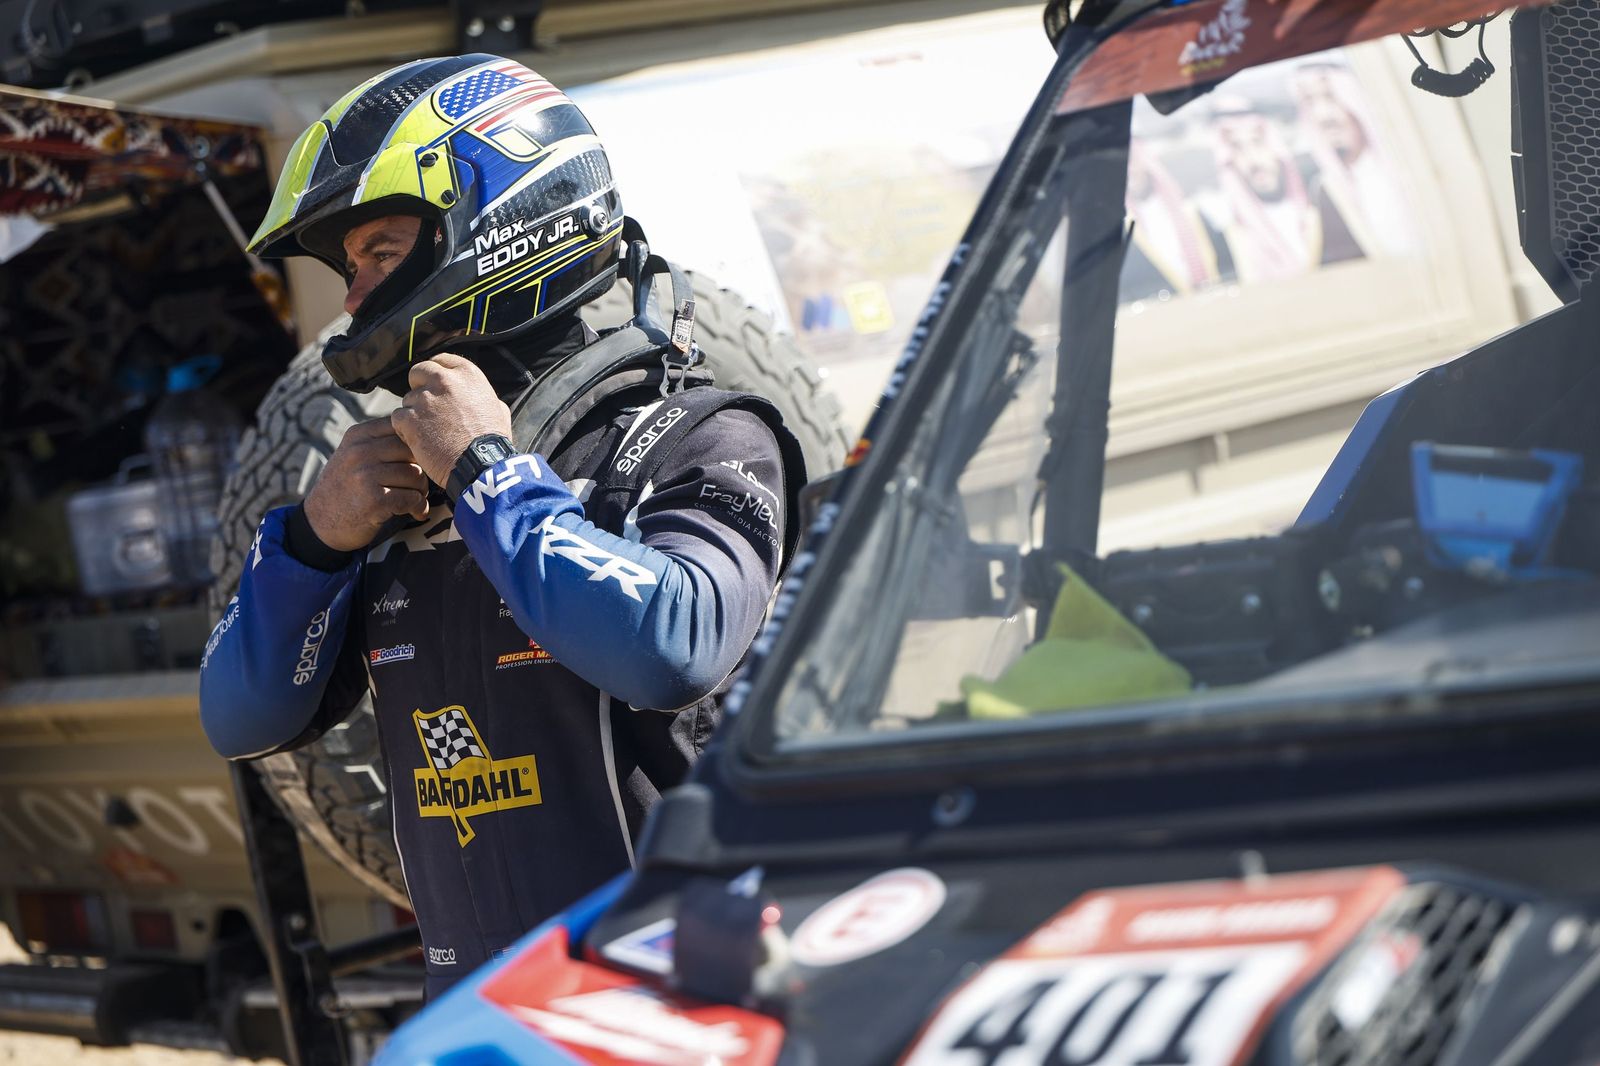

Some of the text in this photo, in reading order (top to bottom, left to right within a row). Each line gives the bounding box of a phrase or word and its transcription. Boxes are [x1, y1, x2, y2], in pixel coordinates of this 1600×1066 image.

[473, 220, 527, 256] Max
[476, 214, 580, 277] EDDY JR.
[616, 407, 687, 476] sparco
[752, 527, 781, 551] FACTO
[292, 610, 331, 686] sparco
[369, 644, 415, 662] BFGoodrich
[495, 660, 533, 670] PROFESSION
[497, 651, 535, 664] ROGER
[417, 767, 533, 810] BARDAHL
[948, 964, 1238, 1066] 401
